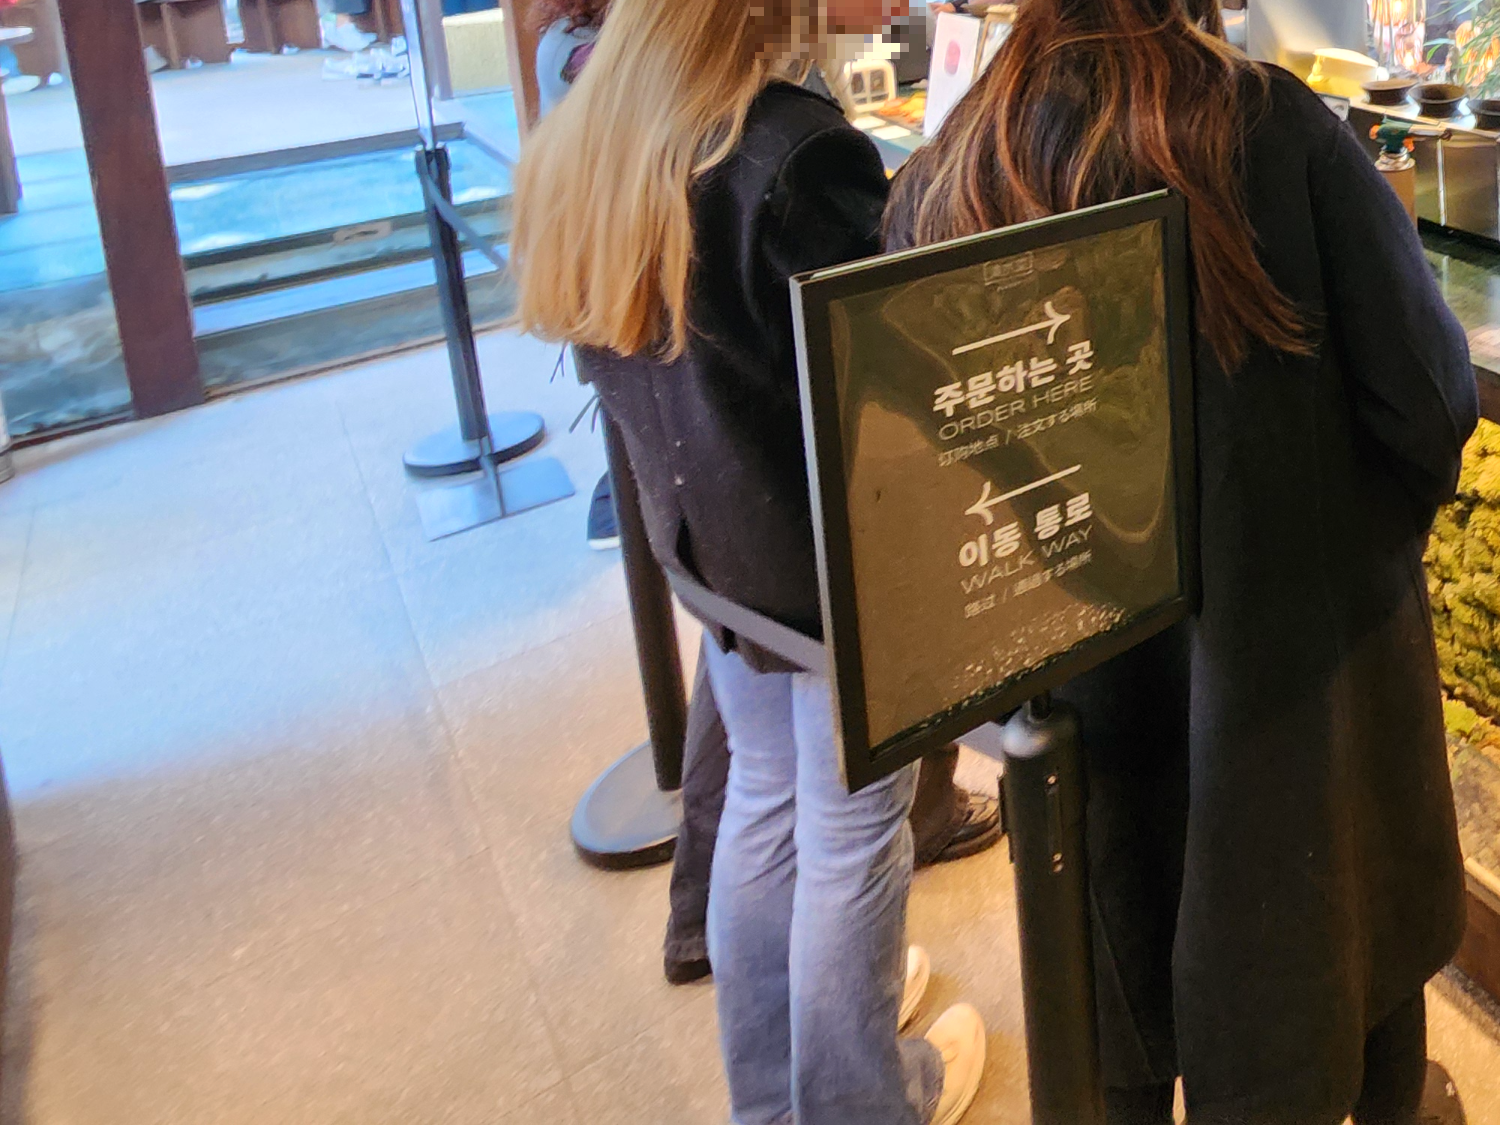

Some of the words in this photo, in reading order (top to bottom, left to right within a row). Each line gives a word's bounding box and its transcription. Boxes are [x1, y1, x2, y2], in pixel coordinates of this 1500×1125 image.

[932, 357, 1058, 418] 주문하는
[1065, 339, 1095, 376] 곳
[938, 398, 1026, 441] ORDER
[1032, 374, 1094, 409] HERE
[958, 520, 1022, 567] 이동
[1033, 491, 1094, 541] 통로
[959, 550, 1036, 595] WALK
[1040, 524, 1093, 558] WAY
